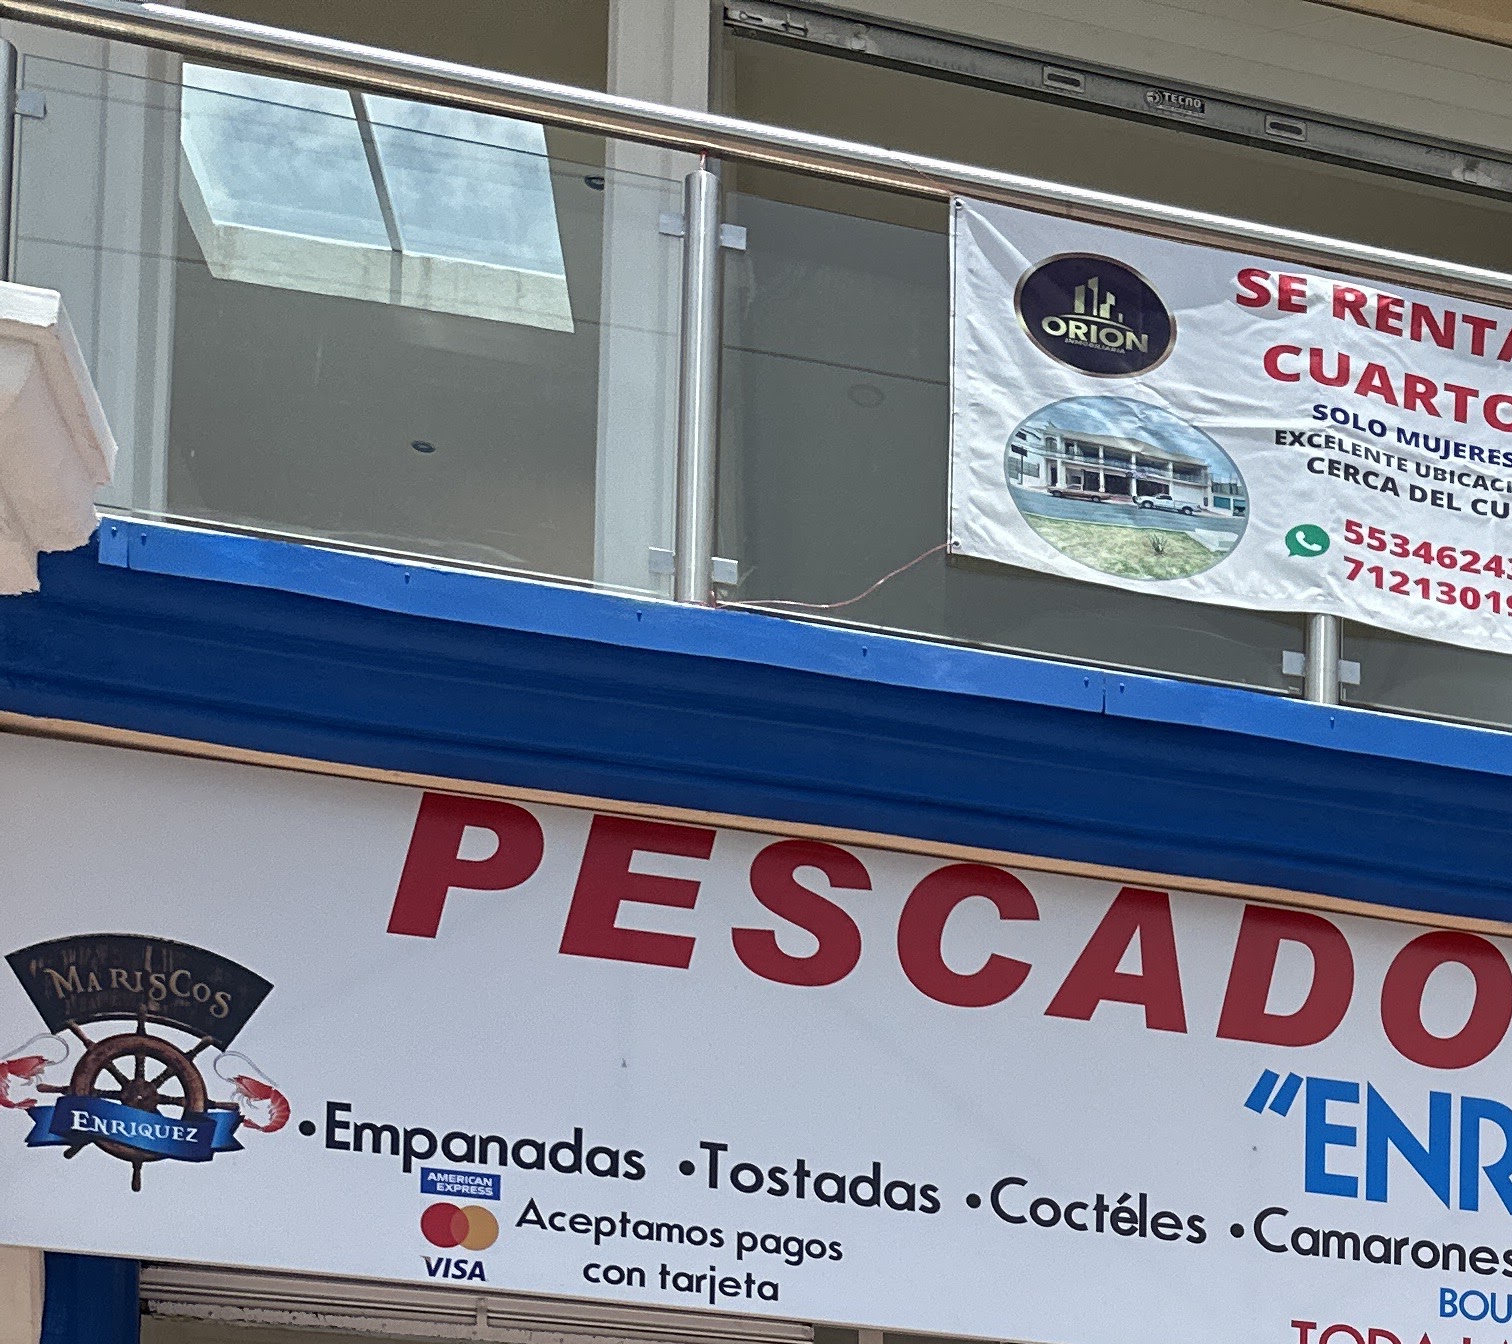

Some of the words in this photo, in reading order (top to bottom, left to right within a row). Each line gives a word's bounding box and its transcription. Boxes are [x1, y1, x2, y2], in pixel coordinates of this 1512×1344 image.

[1236, 267, 1311, 314] SE
[1041, 316, 1149, 353] ORION
[1311, 402, 1387, 438] SOLO
[1274, 429, 1409, 472] EXCELENTE
[1306, 456, 1400, 500] CERCA
[1407, 484, 1463, 514] DEL
[71, 1110, 198, 1142] ENRIQUEZ
[427, 1172, 492, 1186] AMERICAN
[436, 1183, 493, 1196] EXPRESS
[516, 1198, 724, 1255] Aceptamos
[736, 1227, 842, 1266] pagos
[420, 1255, 489, 1281] VISA
[582, 1259, 646, 1286] con
[659, 1264, 779, 1305] tarjeta
